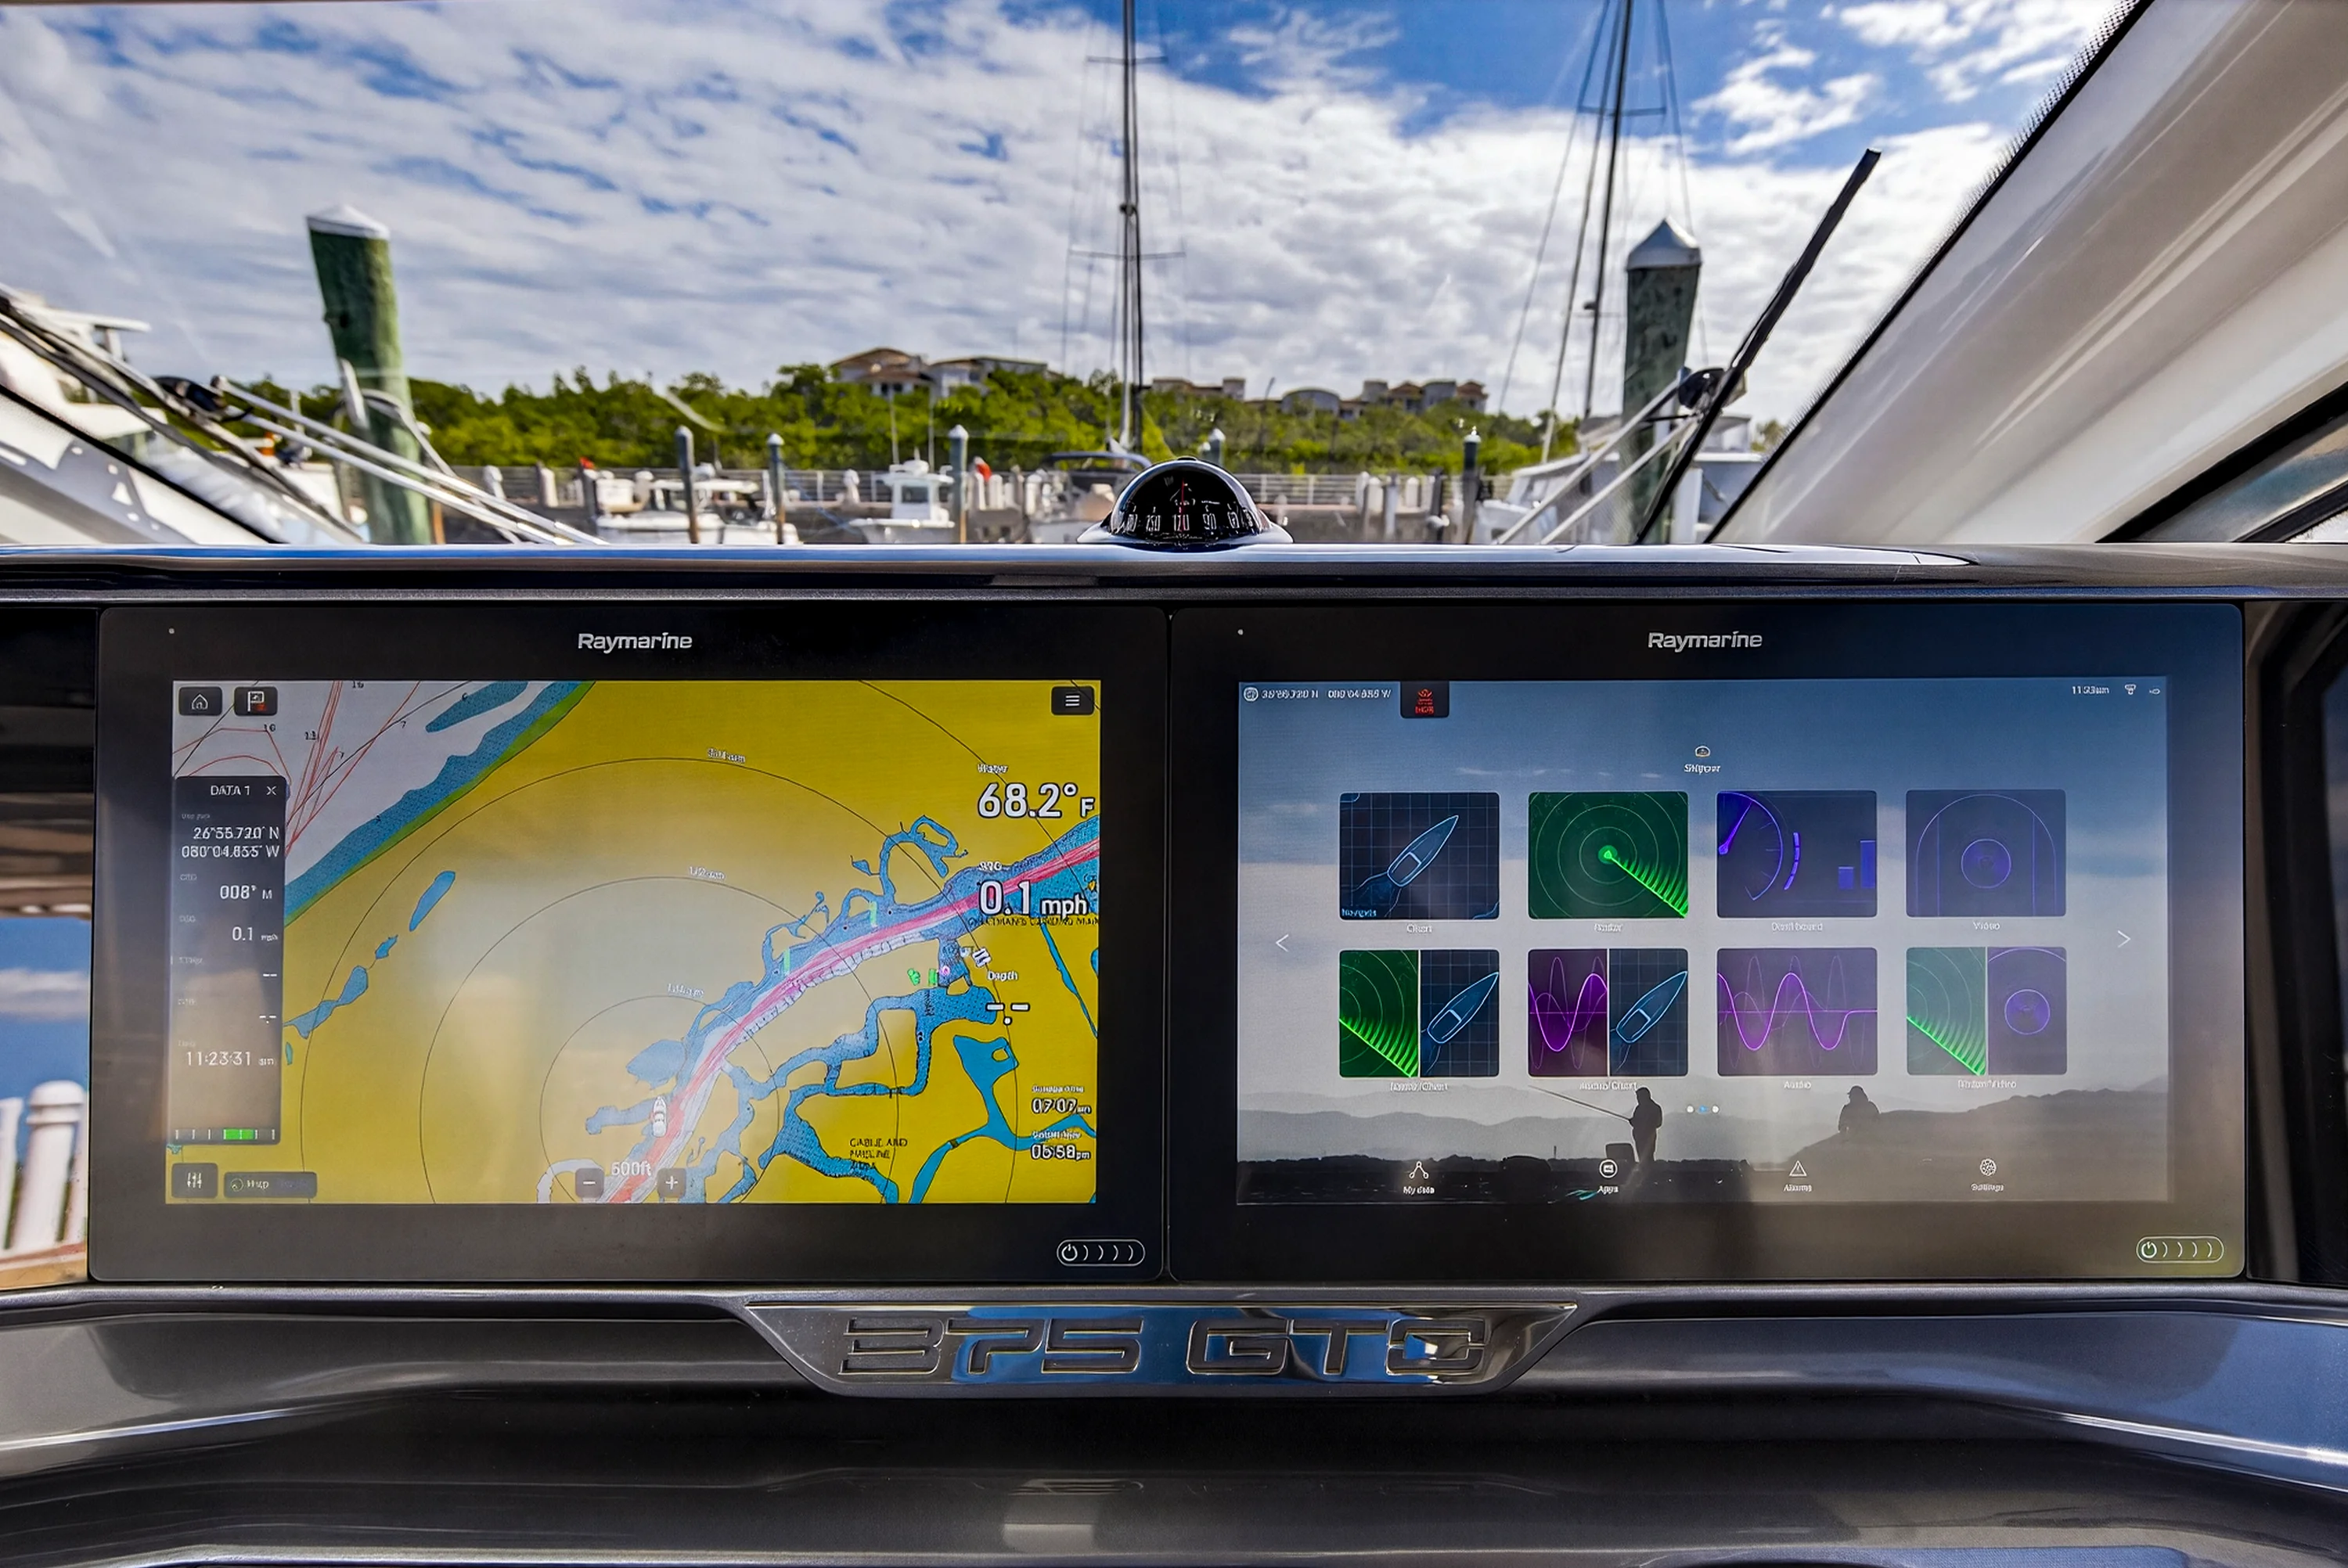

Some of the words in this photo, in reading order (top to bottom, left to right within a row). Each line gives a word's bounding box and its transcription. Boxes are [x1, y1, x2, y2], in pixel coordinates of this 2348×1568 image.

[578, 632, 693, 654] Raymarine
[1648, 631, 1763, 653] Raymarine
[211, 786, 241, 796] DATA
[1081, 797, 1095, 818] F
[269, 827, 279, 840] N
[265, 845, 279, 858] W
[978, 879, 1032, 915] 0.1
[1040, 893, 1089, 922] mph
[232, 926, 254, 941] 0.1
